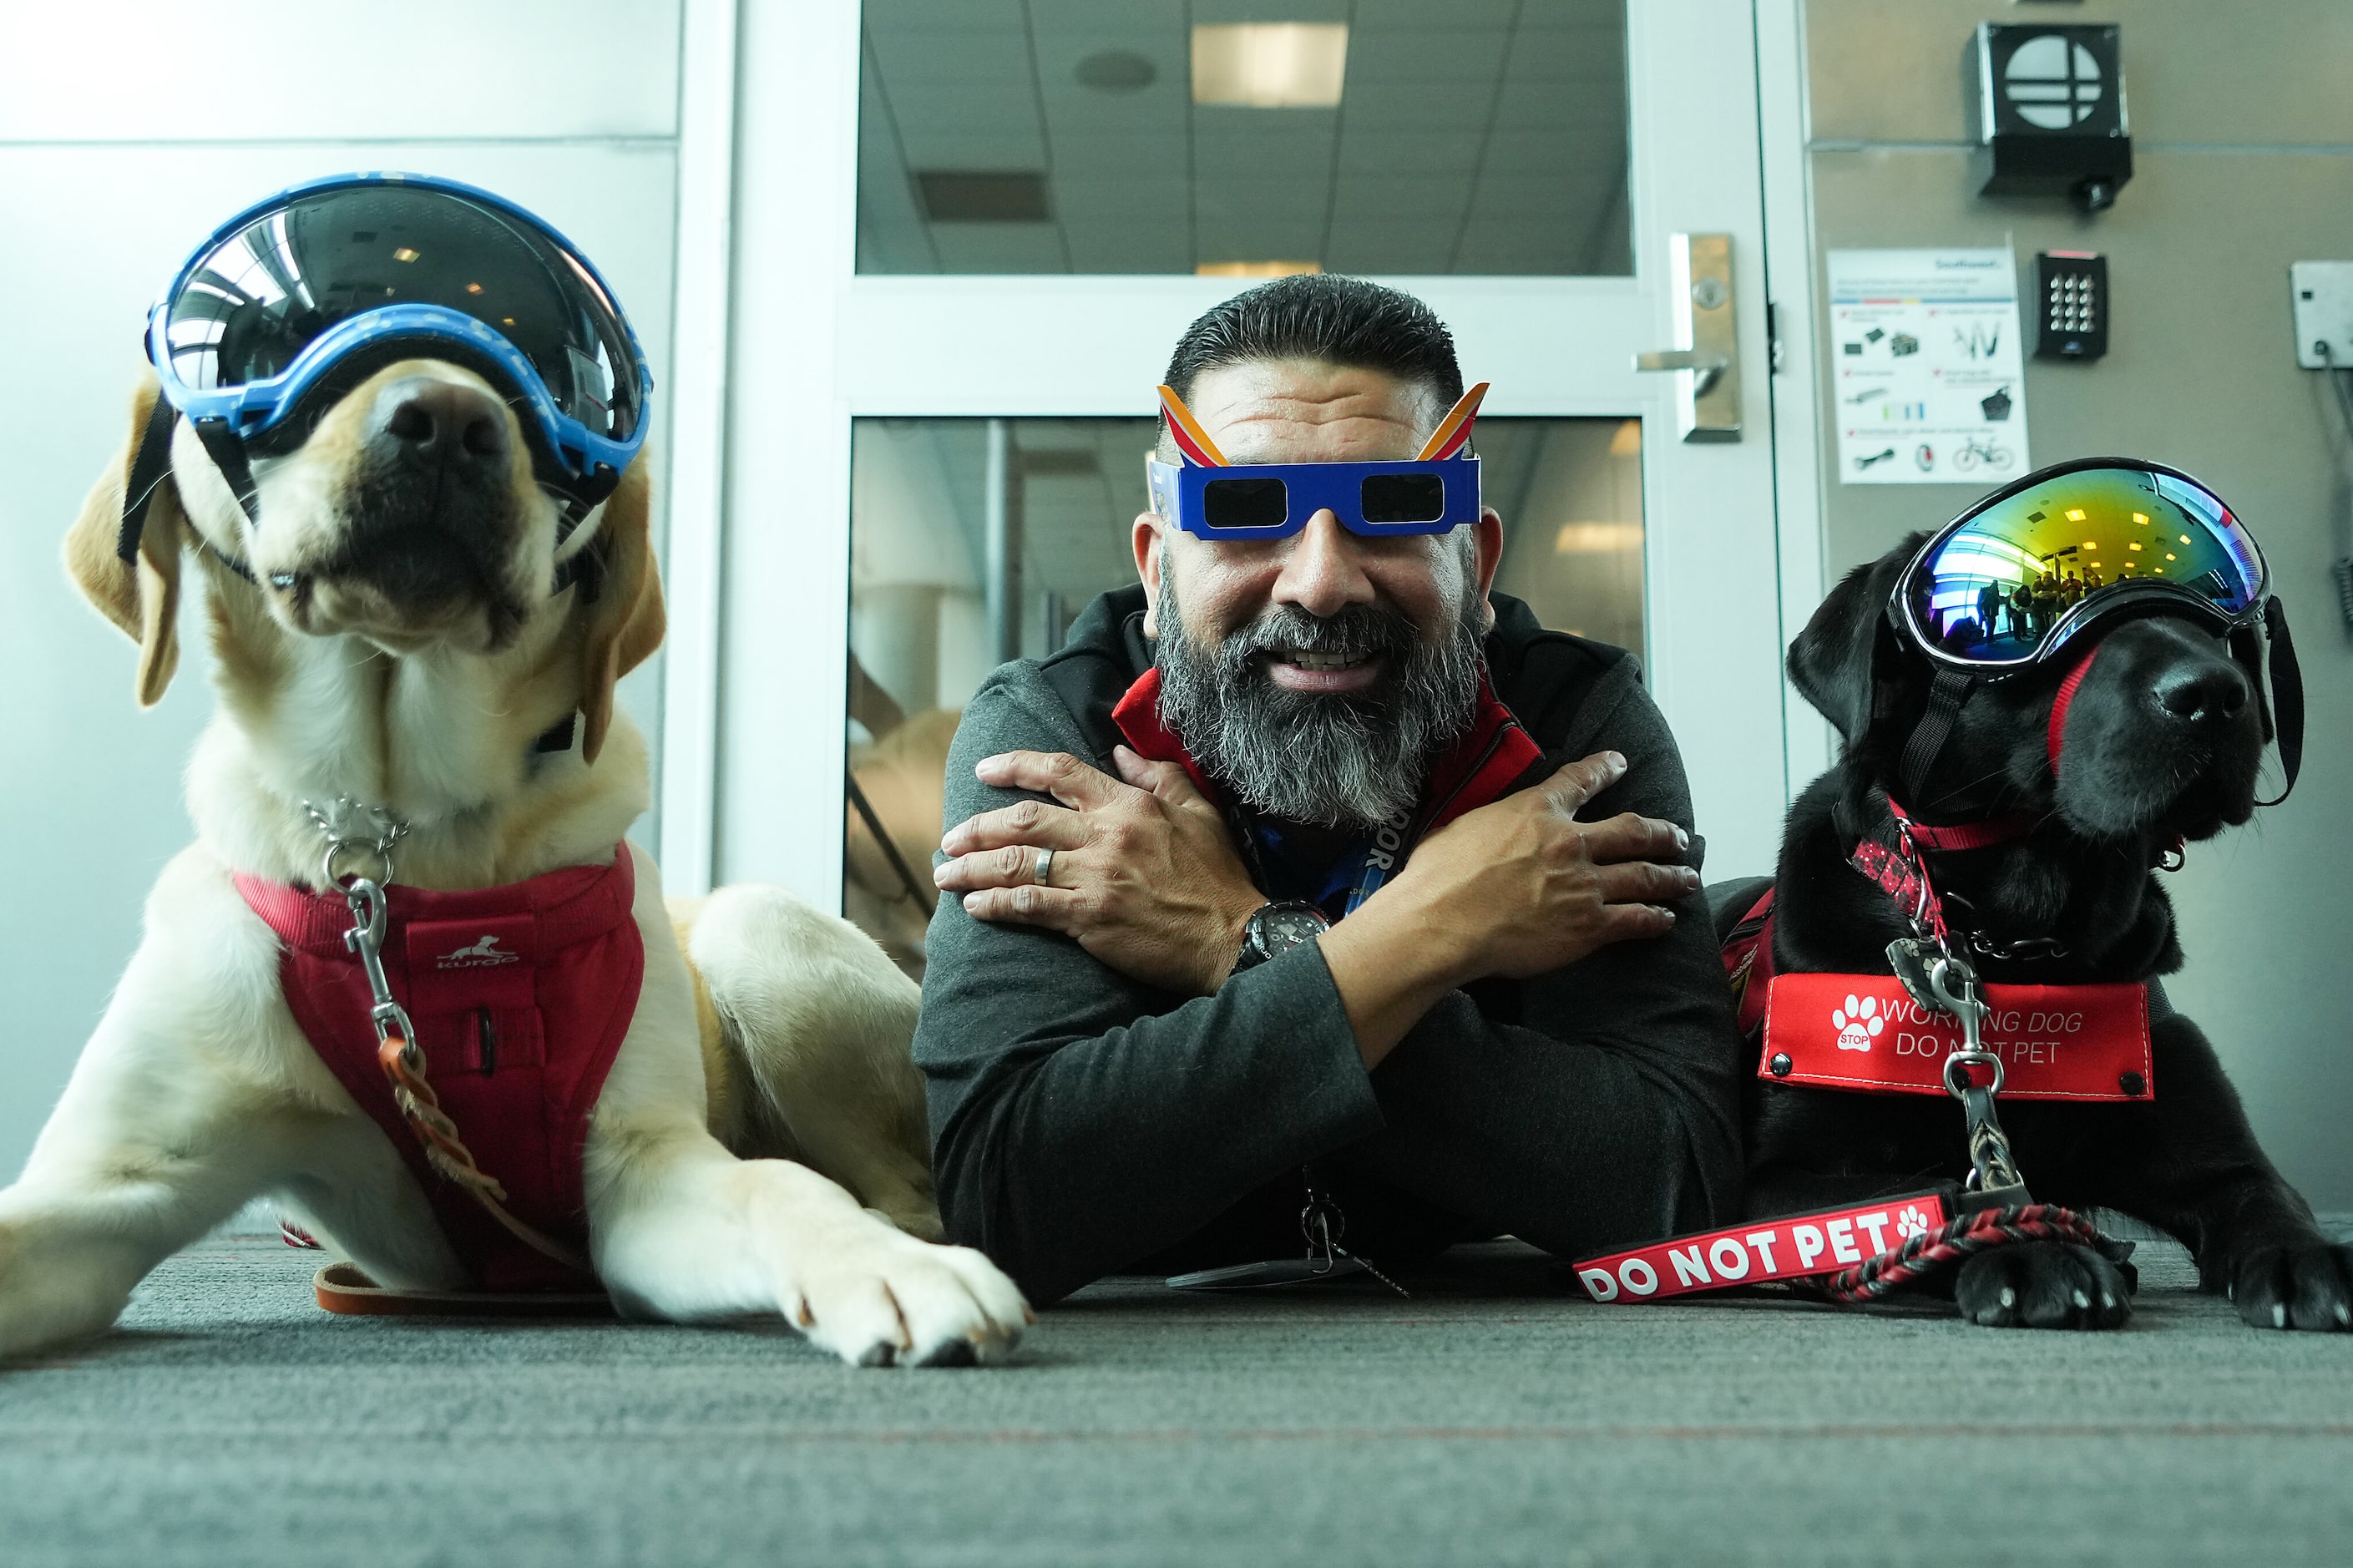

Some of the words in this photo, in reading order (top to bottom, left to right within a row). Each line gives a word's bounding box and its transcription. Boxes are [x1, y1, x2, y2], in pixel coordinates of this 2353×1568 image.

[436, 956, 520, 969] kurgo
[2028, 1012, 2082, 1034] DOG
[1840, 1034, 1869, 1044] STOP
[1896, 1032, 1939, 1057] DO
[2013, 1041, 2060, 1064] PET
[1578, 1258, 1659, 1302] DO
[1667, 1230, 1779, 1287] NOT
[1792, 1211, 1890, 1268] PET
